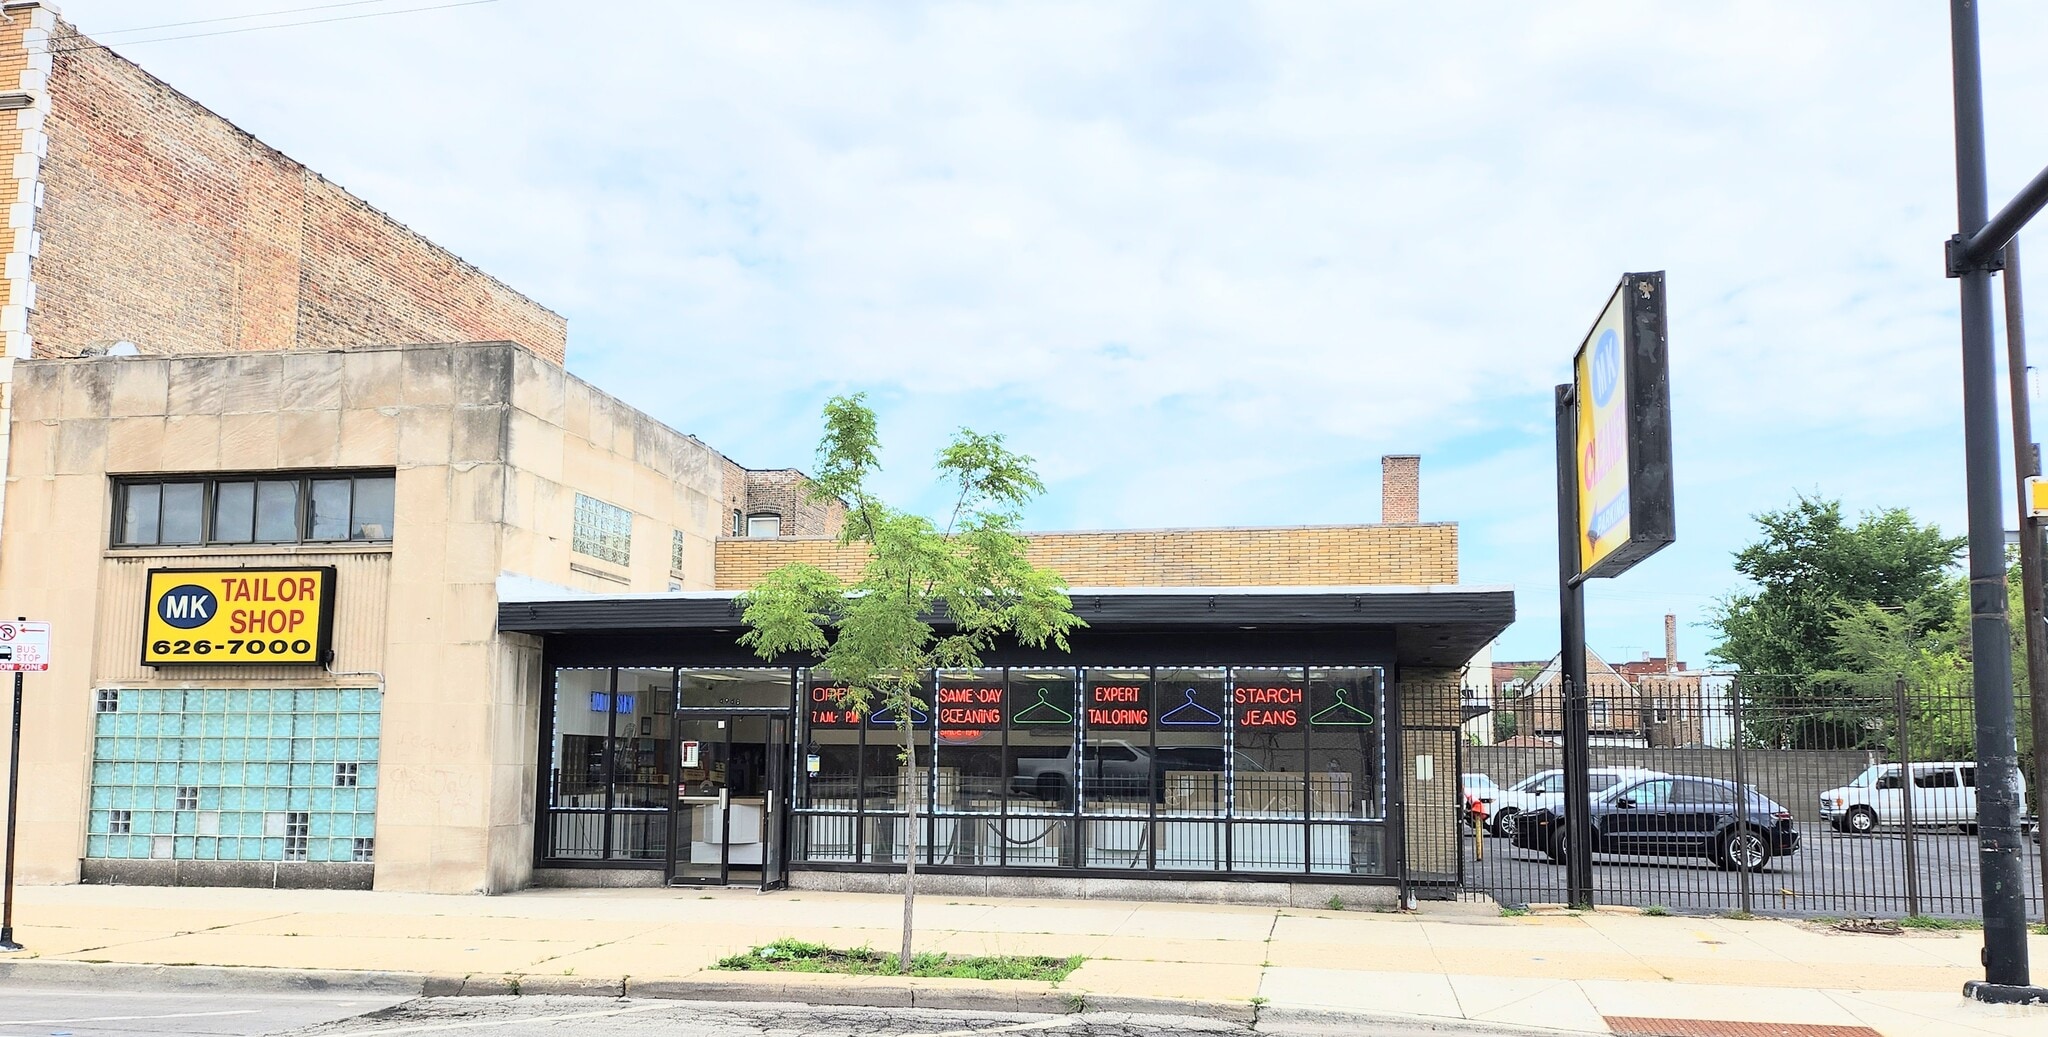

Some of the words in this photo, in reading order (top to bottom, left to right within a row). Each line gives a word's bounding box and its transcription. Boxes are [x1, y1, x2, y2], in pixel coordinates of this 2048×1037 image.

[1595, 336, 1617, 399] MK
[1597, 495, 1626, 536] PARKING
[221, 577, 316, 602] TAILOR
[166, 594, 209, 619] MK
[230, 609, 305, 634] SHOP
[16, 645, 37, 653] BUS
[152, 640, 311, 655] 626-7000
[16, 654, 41, 662] STOP
[813, 687, 857, 702] OPE
[1095, 687, 1140, 702] EXPERT
[1235, 688, 1302, 704] STARCH
[941, 708, 1000, 723] CLEANING
[1088, 709, 1148, 725] TAILORING
[1240, 710, 1297, 726] JEANS
